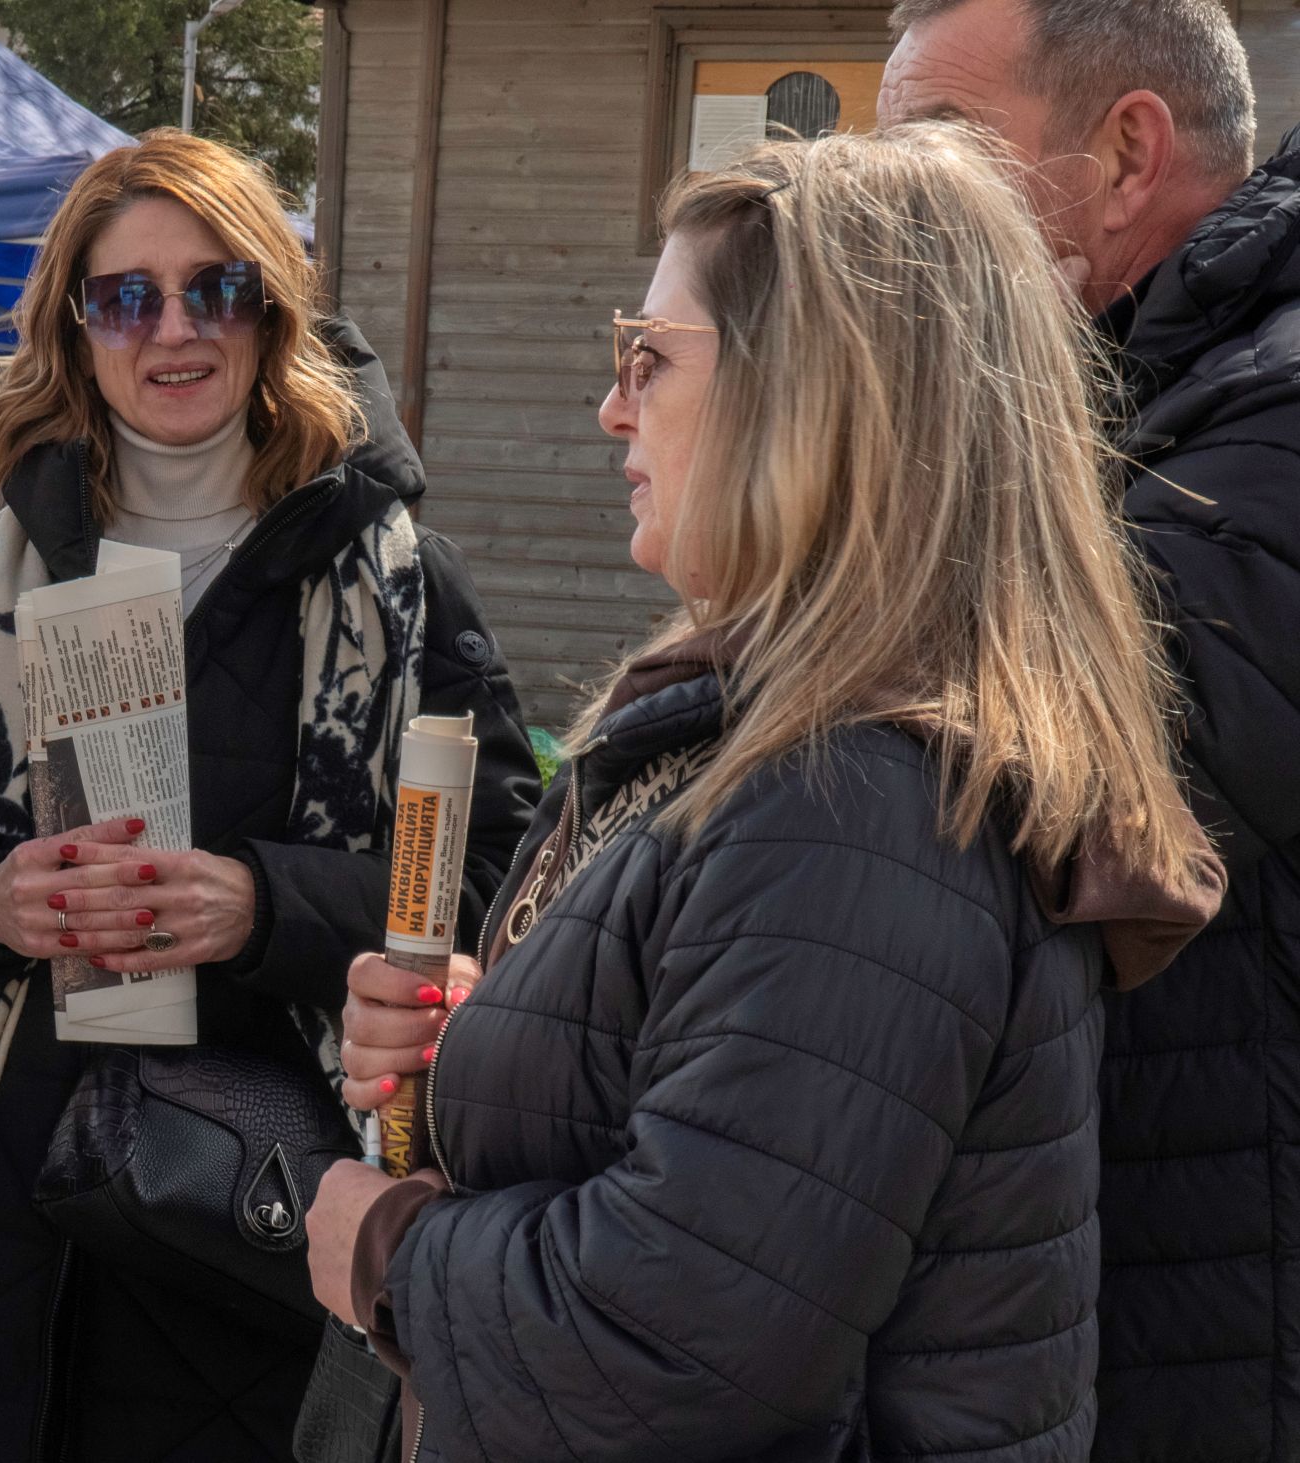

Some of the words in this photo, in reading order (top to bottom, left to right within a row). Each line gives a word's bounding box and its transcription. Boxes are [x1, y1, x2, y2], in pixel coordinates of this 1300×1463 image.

[396, 801, 420, 921] ЛИКВИДАЦИЯ
[412, 795, 438, 905] КОРУПЦИЯТА
[410, 911, 424, 932] НА
